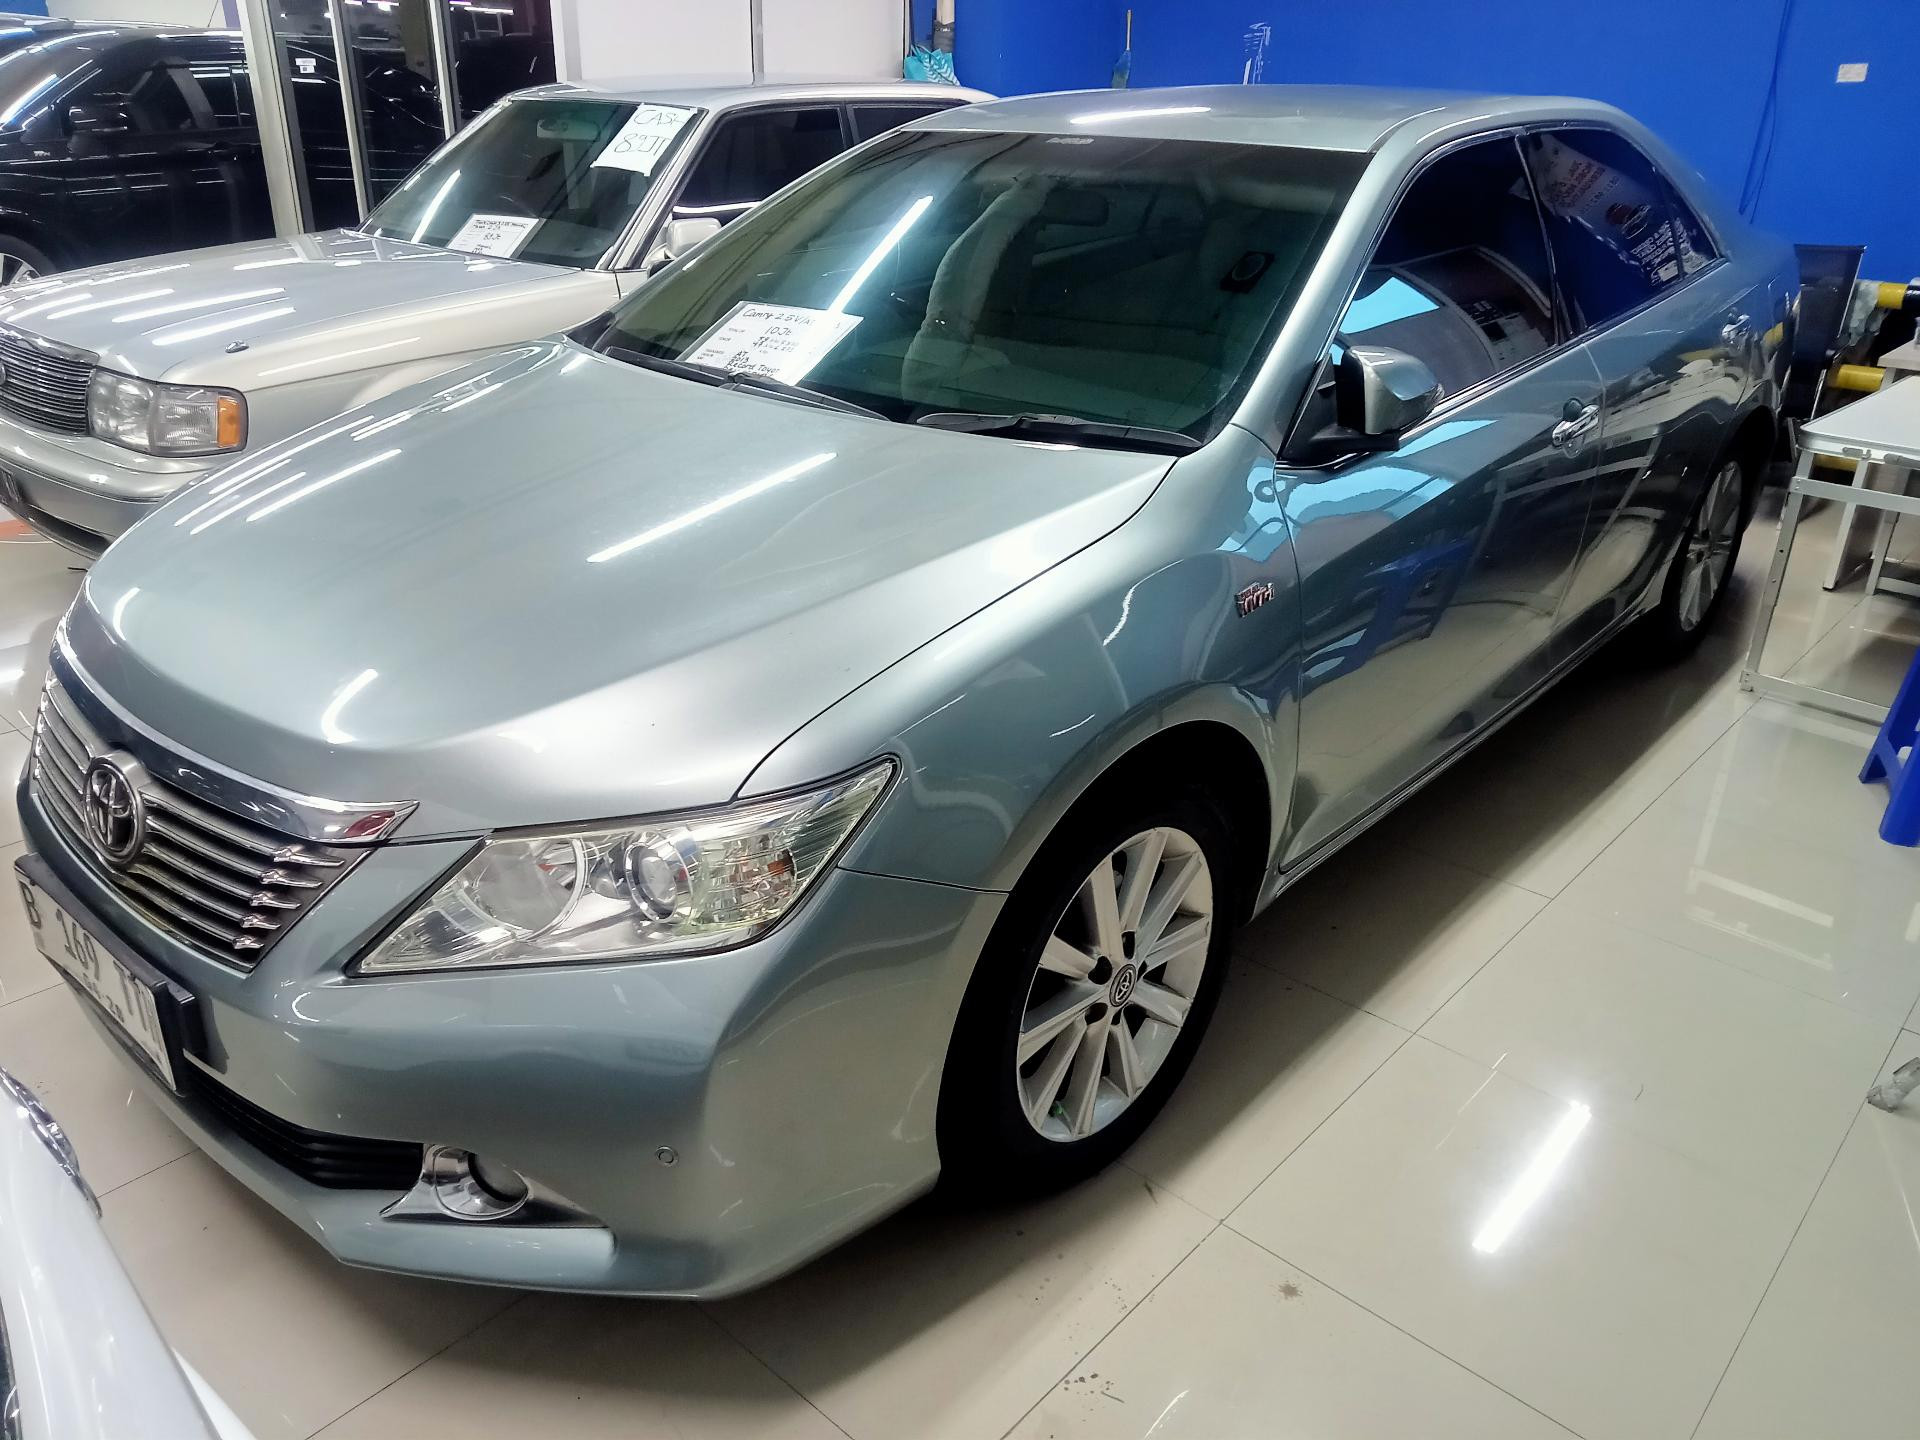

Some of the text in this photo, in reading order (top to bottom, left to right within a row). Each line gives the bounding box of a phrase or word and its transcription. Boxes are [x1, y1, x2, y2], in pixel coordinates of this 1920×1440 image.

[743, 308, 774, 320] Camry
[18, 879, 42, 930] B
[56, 908, 100, 982] 169
